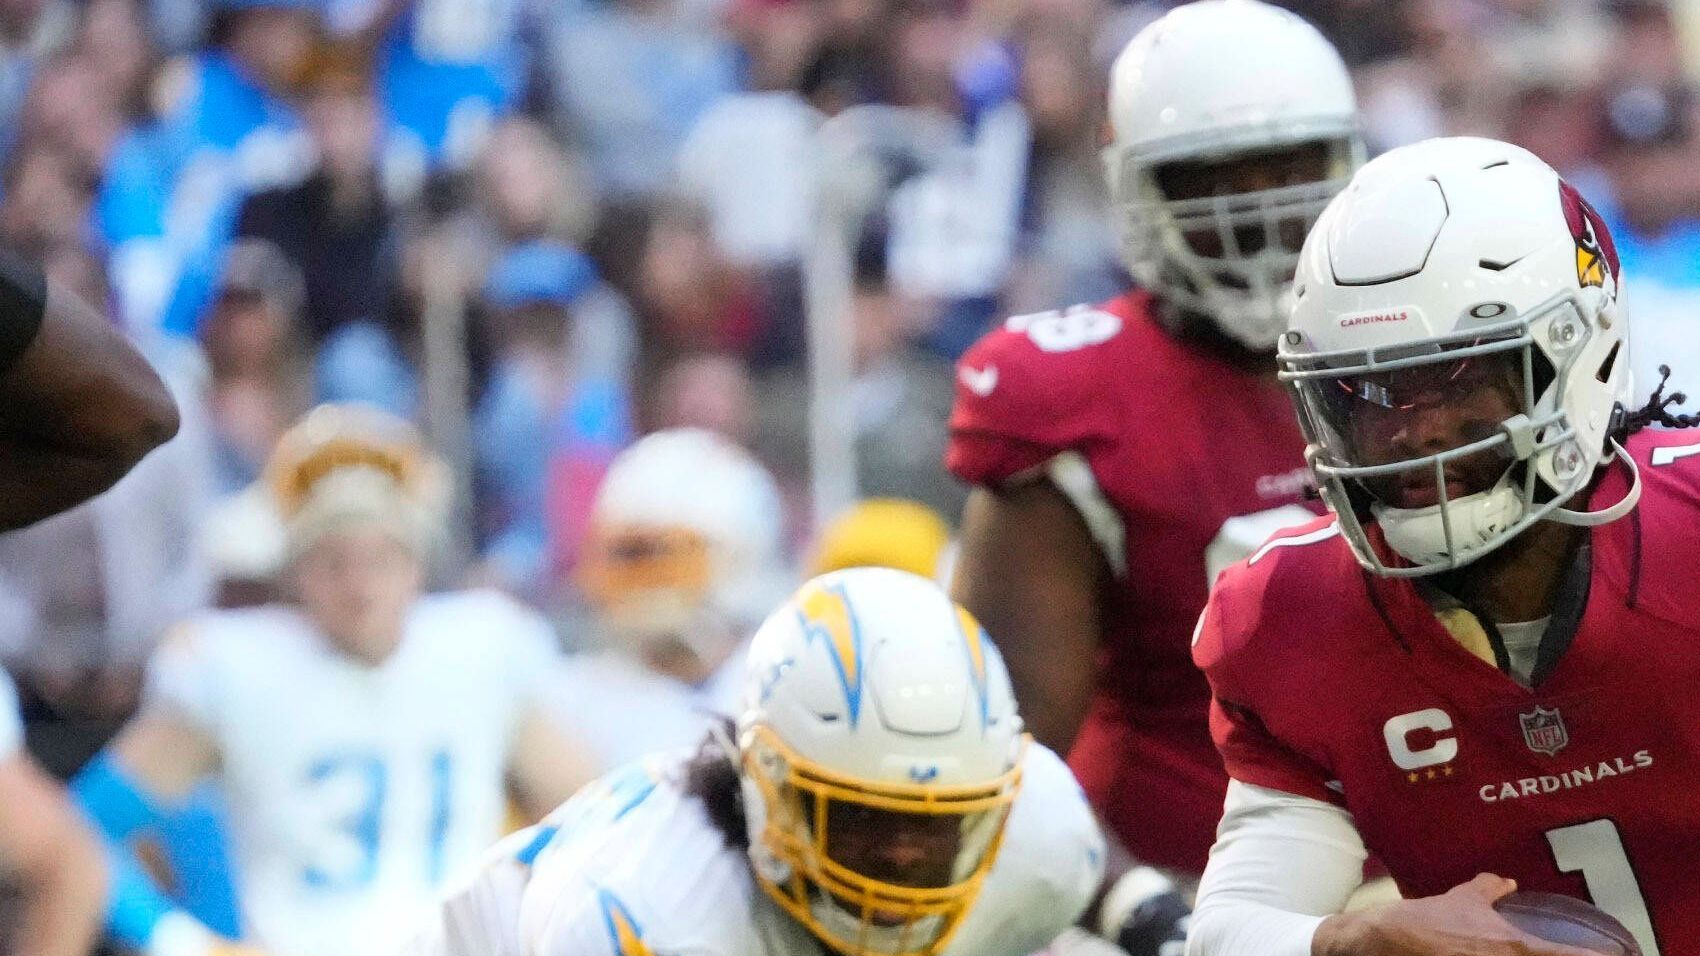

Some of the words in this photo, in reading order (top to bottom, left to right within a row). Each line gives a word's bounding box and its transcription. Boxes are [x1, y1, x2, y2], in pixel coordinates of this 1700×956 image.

[1340, 311, 1408, 328] CARDINALS
[1383, 707, 1458, 770] C
[1478, 749, 1654, 803] CARDINALS
[302, 744, 456, 890] 31
